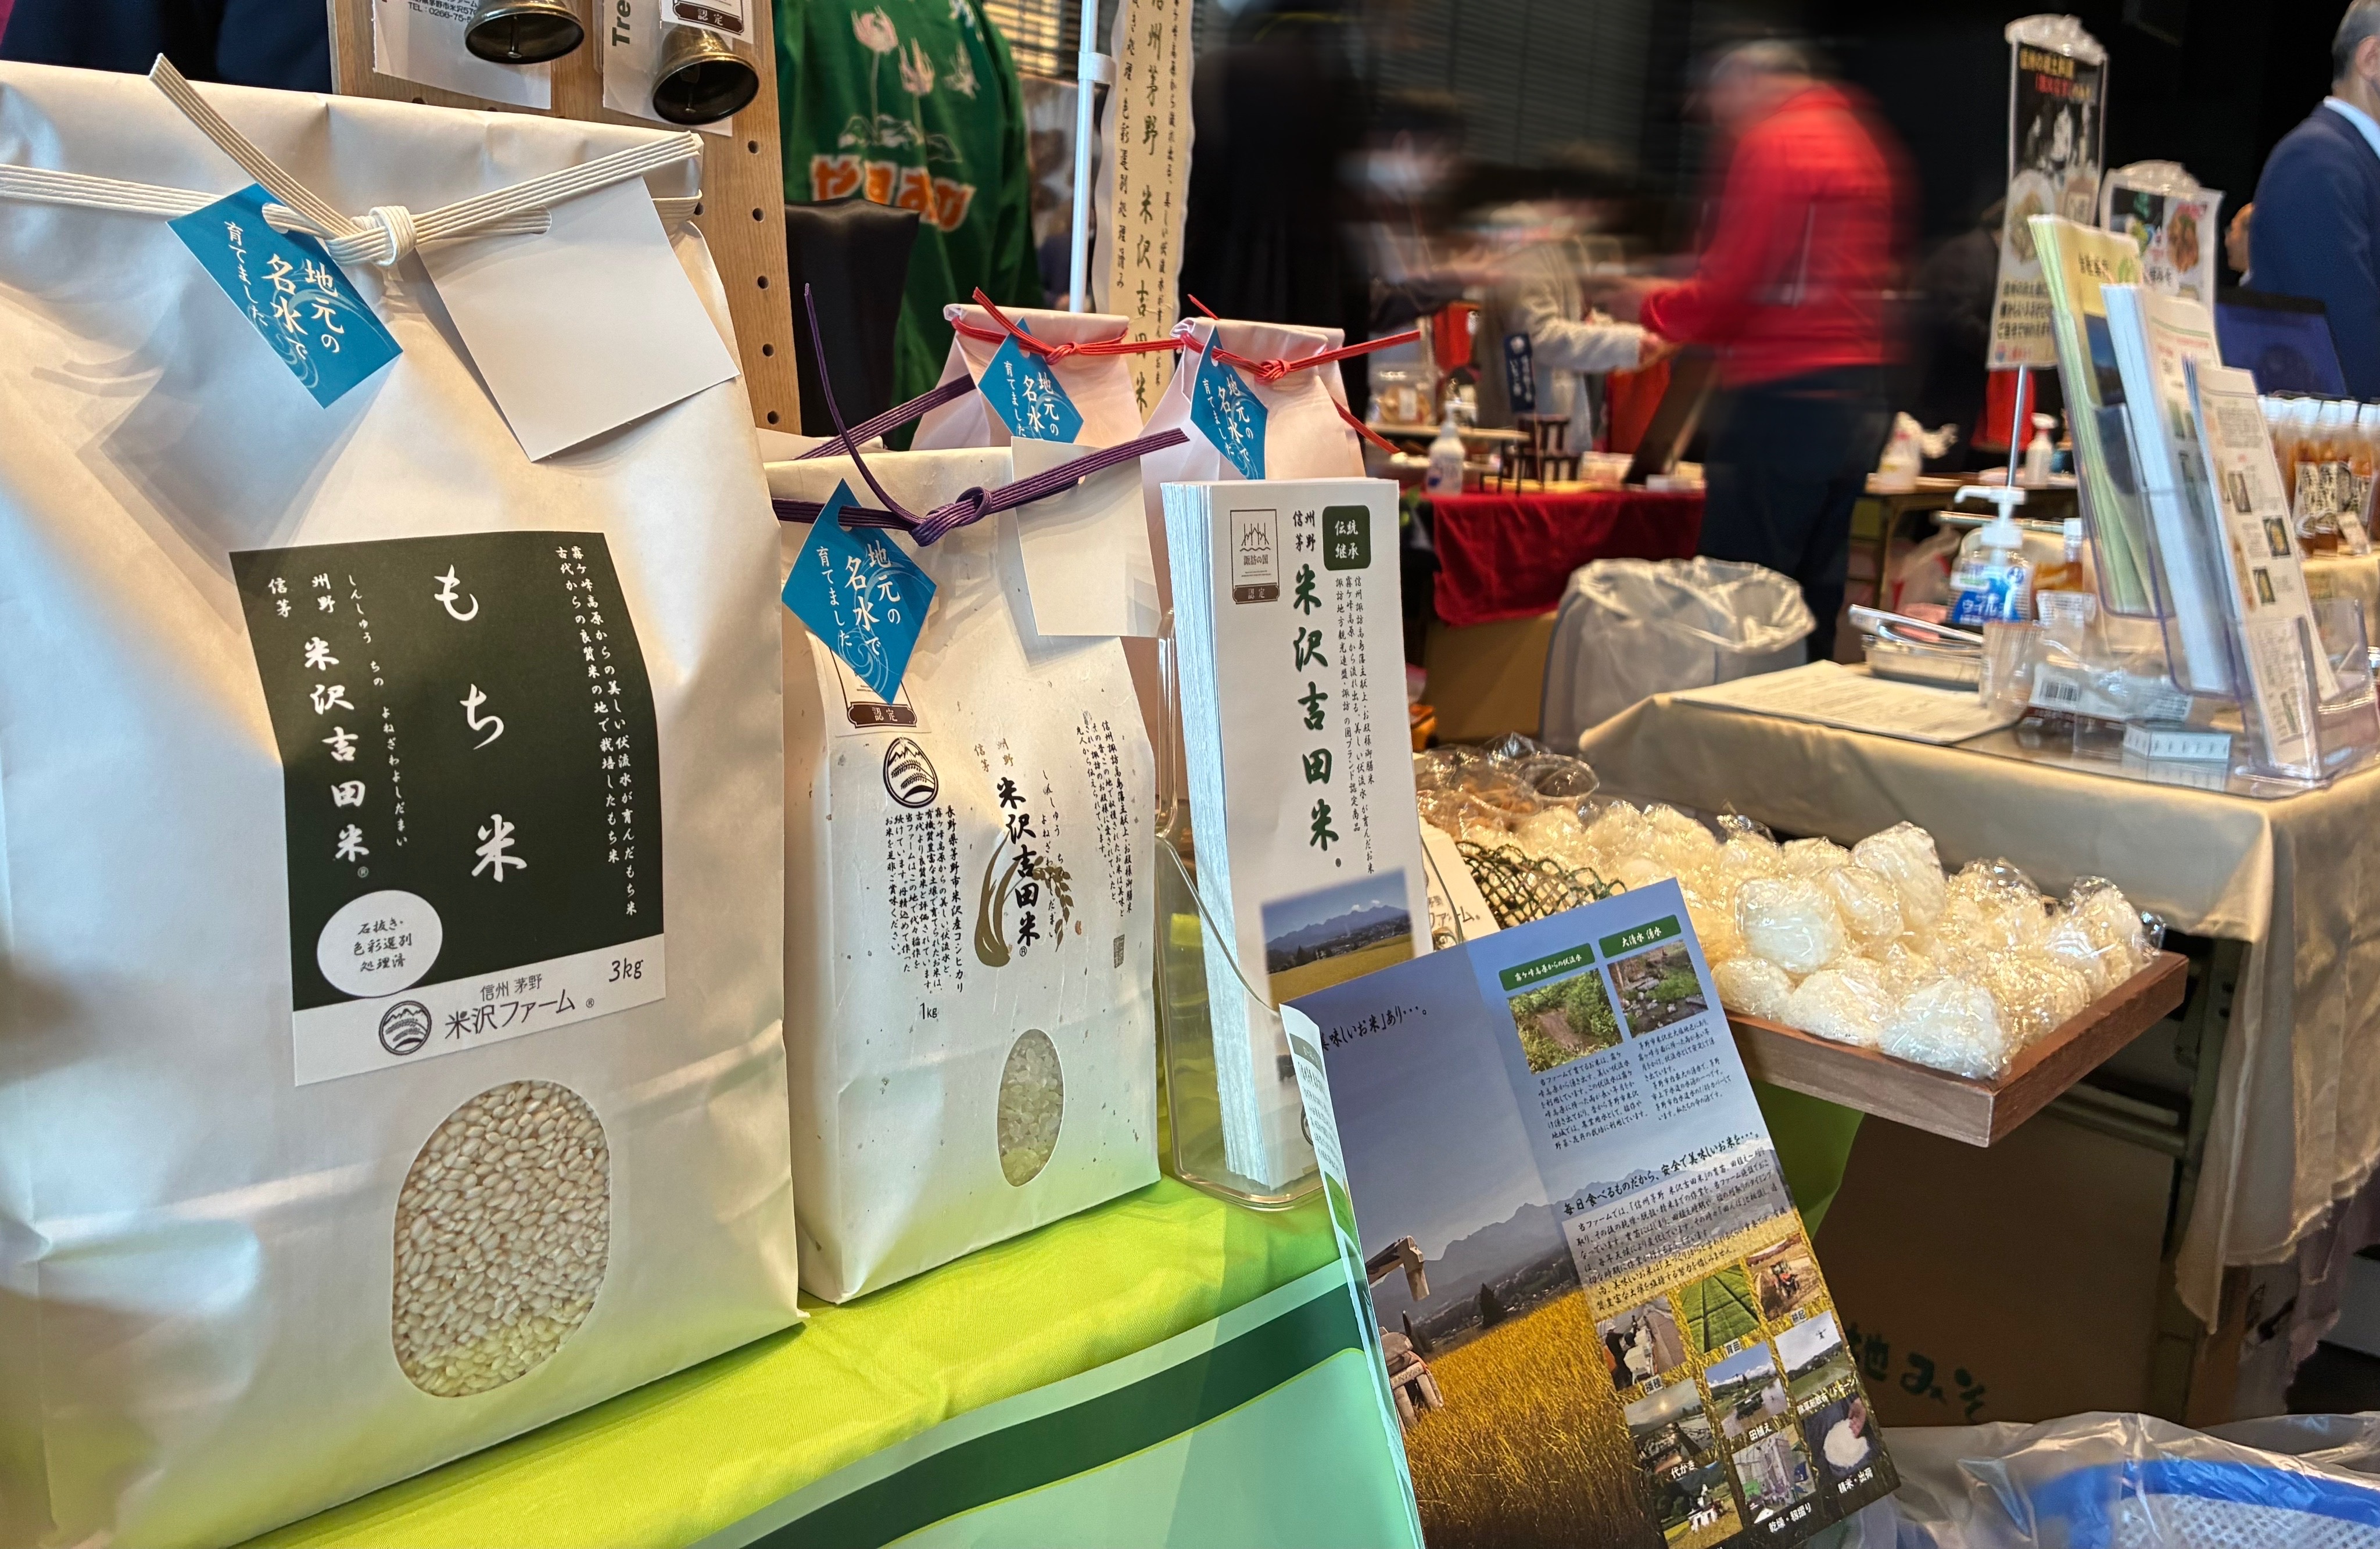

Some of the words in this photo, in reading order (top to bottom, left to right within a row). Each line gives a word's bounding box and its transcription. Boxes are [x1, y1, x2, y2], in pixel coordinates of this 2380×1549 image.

[698, 8, 723, 26] 認定
[224, 221, 268, 327] 育てました
[261, 253, 308, 360] 名水で
[304, 259, 345, 353] 地元の
[1004, 361, 1026, 437] 育てました
[1038, 372, 1059, 436] 地元の
[1202, 378, 1234, 456] 育てました
[1218, 385, 1250, 462] 名水で
[1226, 374, 1253, 439] 地元の
[1243, 554, 1268, 566] 諏訪の国
[1335, 519, 1359, 536] 伝統
[1335, 543, 1359, 560] 継承
[816, 545, 852, 648] 育てました
[844, 555, 881, 656] 名水で
[867, 539, 901, 625] 地元の
[1248, 587, 1266, 600] 認定
[349, 574, 371, 644] しんしゅう
[370, 661, 384, 686] ちの
[382, 706, 408, 847] よねざわよしだまい
[433, 564, 528, 883] もち米
[555, 546, 619, 863] 古代からの良質米の地で栽培したもち米
[872, 707, 898, 723] 認定
[1292, 563, 1339, 851] 米沢吉田米
[304, 636, 370, 862] 米沢吉田米
[885, 817, 902, 957] お米を是非ご賞味ください。
[894, 815, 912, 974] 続けています。丹精込めて作った
[905, 813, 921, 970] 当ファームはこの地で代々稲作を
[945, 805, 963, 994] 長野県茅野市米沢産コシヒカリ
[997, 777, 1041, 948] 米沢吉田米
[915, 812, 933, 995] 古代より良質米と評価されています。
[354, 933, 413, 956] 色彩選別
[360, 954, 406, 973] 処理済
[608, 959, 644, 983] 3kg
[445, 989, 576, 1041] 米沢ファーム
[480, 984, 509, 1002] 信州
[514, 973, 543, 994] 茅野
[919, 1002, 938, 1020] 1kg
[1671, 1461, 1696, 1478] 代かき
[1748, 1423, 1772, 1441] 田植え
